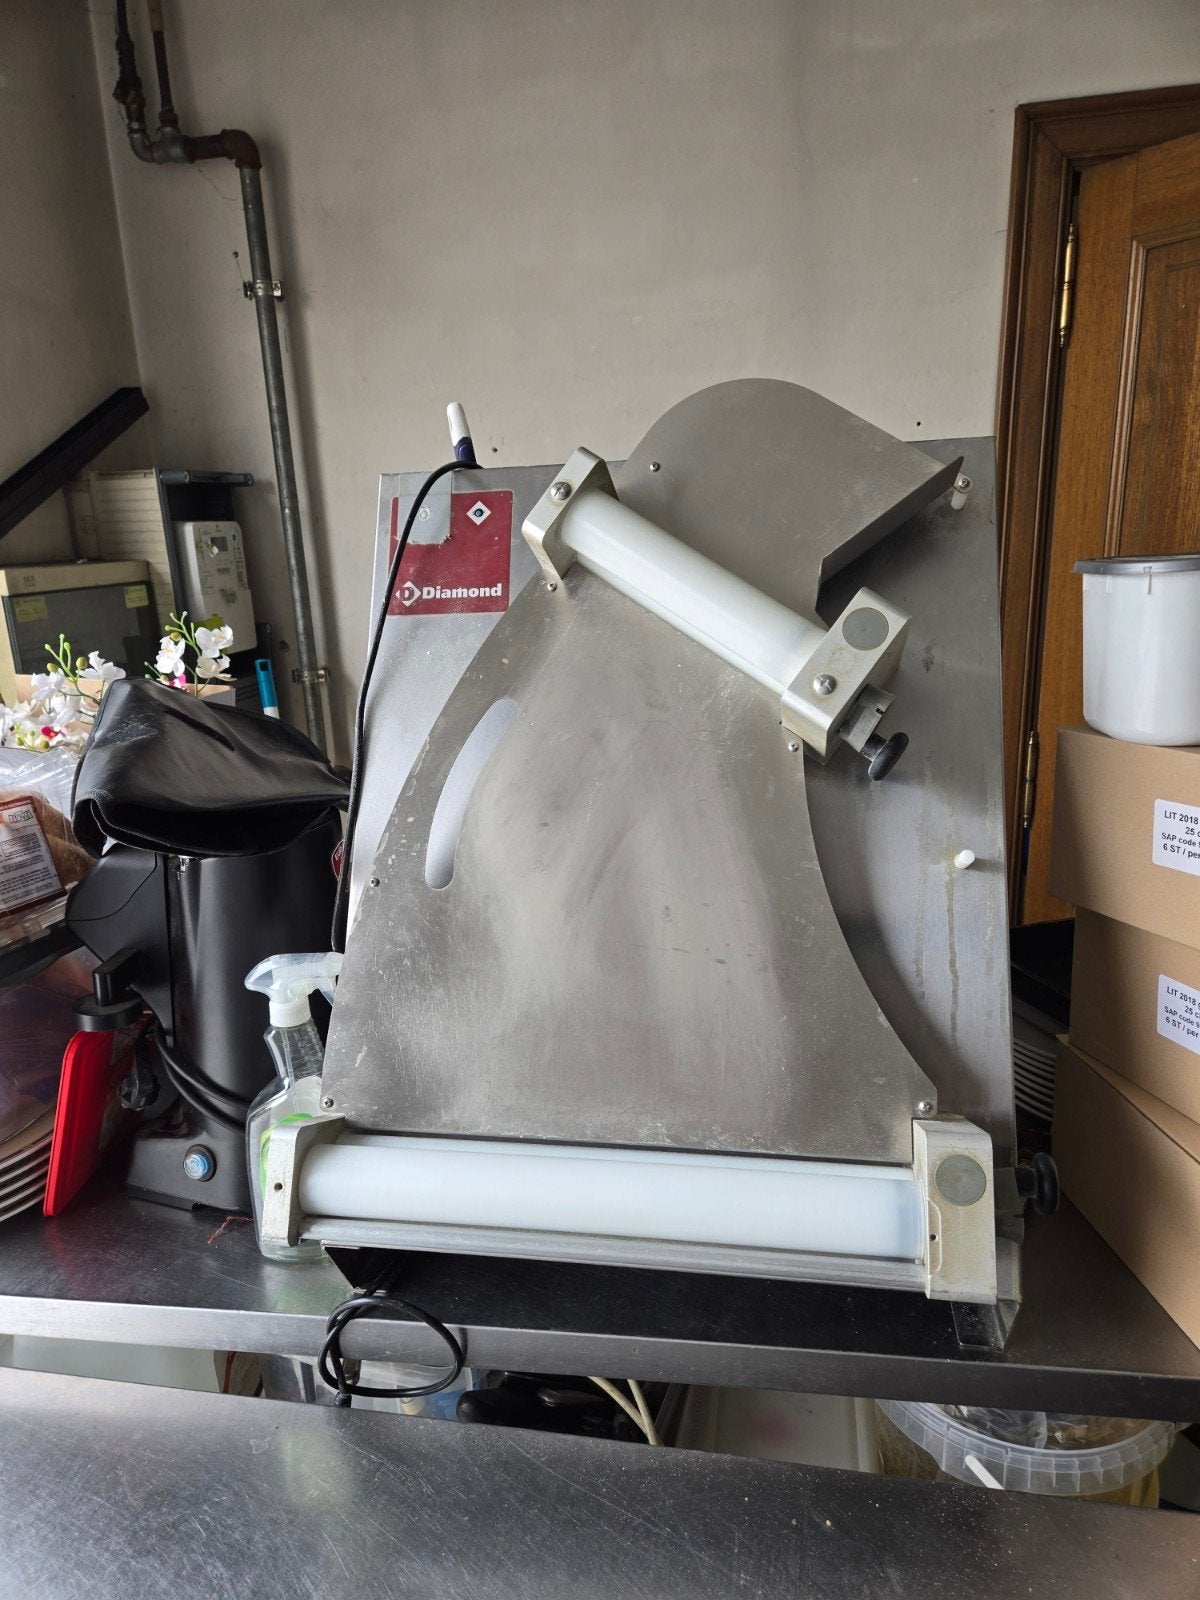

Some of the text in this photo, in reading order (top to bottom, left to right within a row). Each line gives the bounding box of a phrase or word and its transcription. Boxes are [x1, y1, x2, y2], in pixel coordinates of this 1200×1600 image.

[422, 583, 502, 599] Diamond
[1164, 810, 1199, 825] LIT 2018
[1185, 827, 1195, 835] 25
[1161, 832, 1177, 841] SAP
[1178, 838, 1196, 847] code
[1163, 843, 1168, 851] 6
[1170, 845, 1181, 854] ST
[1166, 986, 1197, 1006] LIT 2018
[1164, 1006, 1177, 1016] SAP
[1179, 1015, 1194, 1026] code
[1184, 1006, 1193, 1015] 25
[1171, 1019, 1181, 1028] ST
[1187, 1028, 1199, 1038] per
